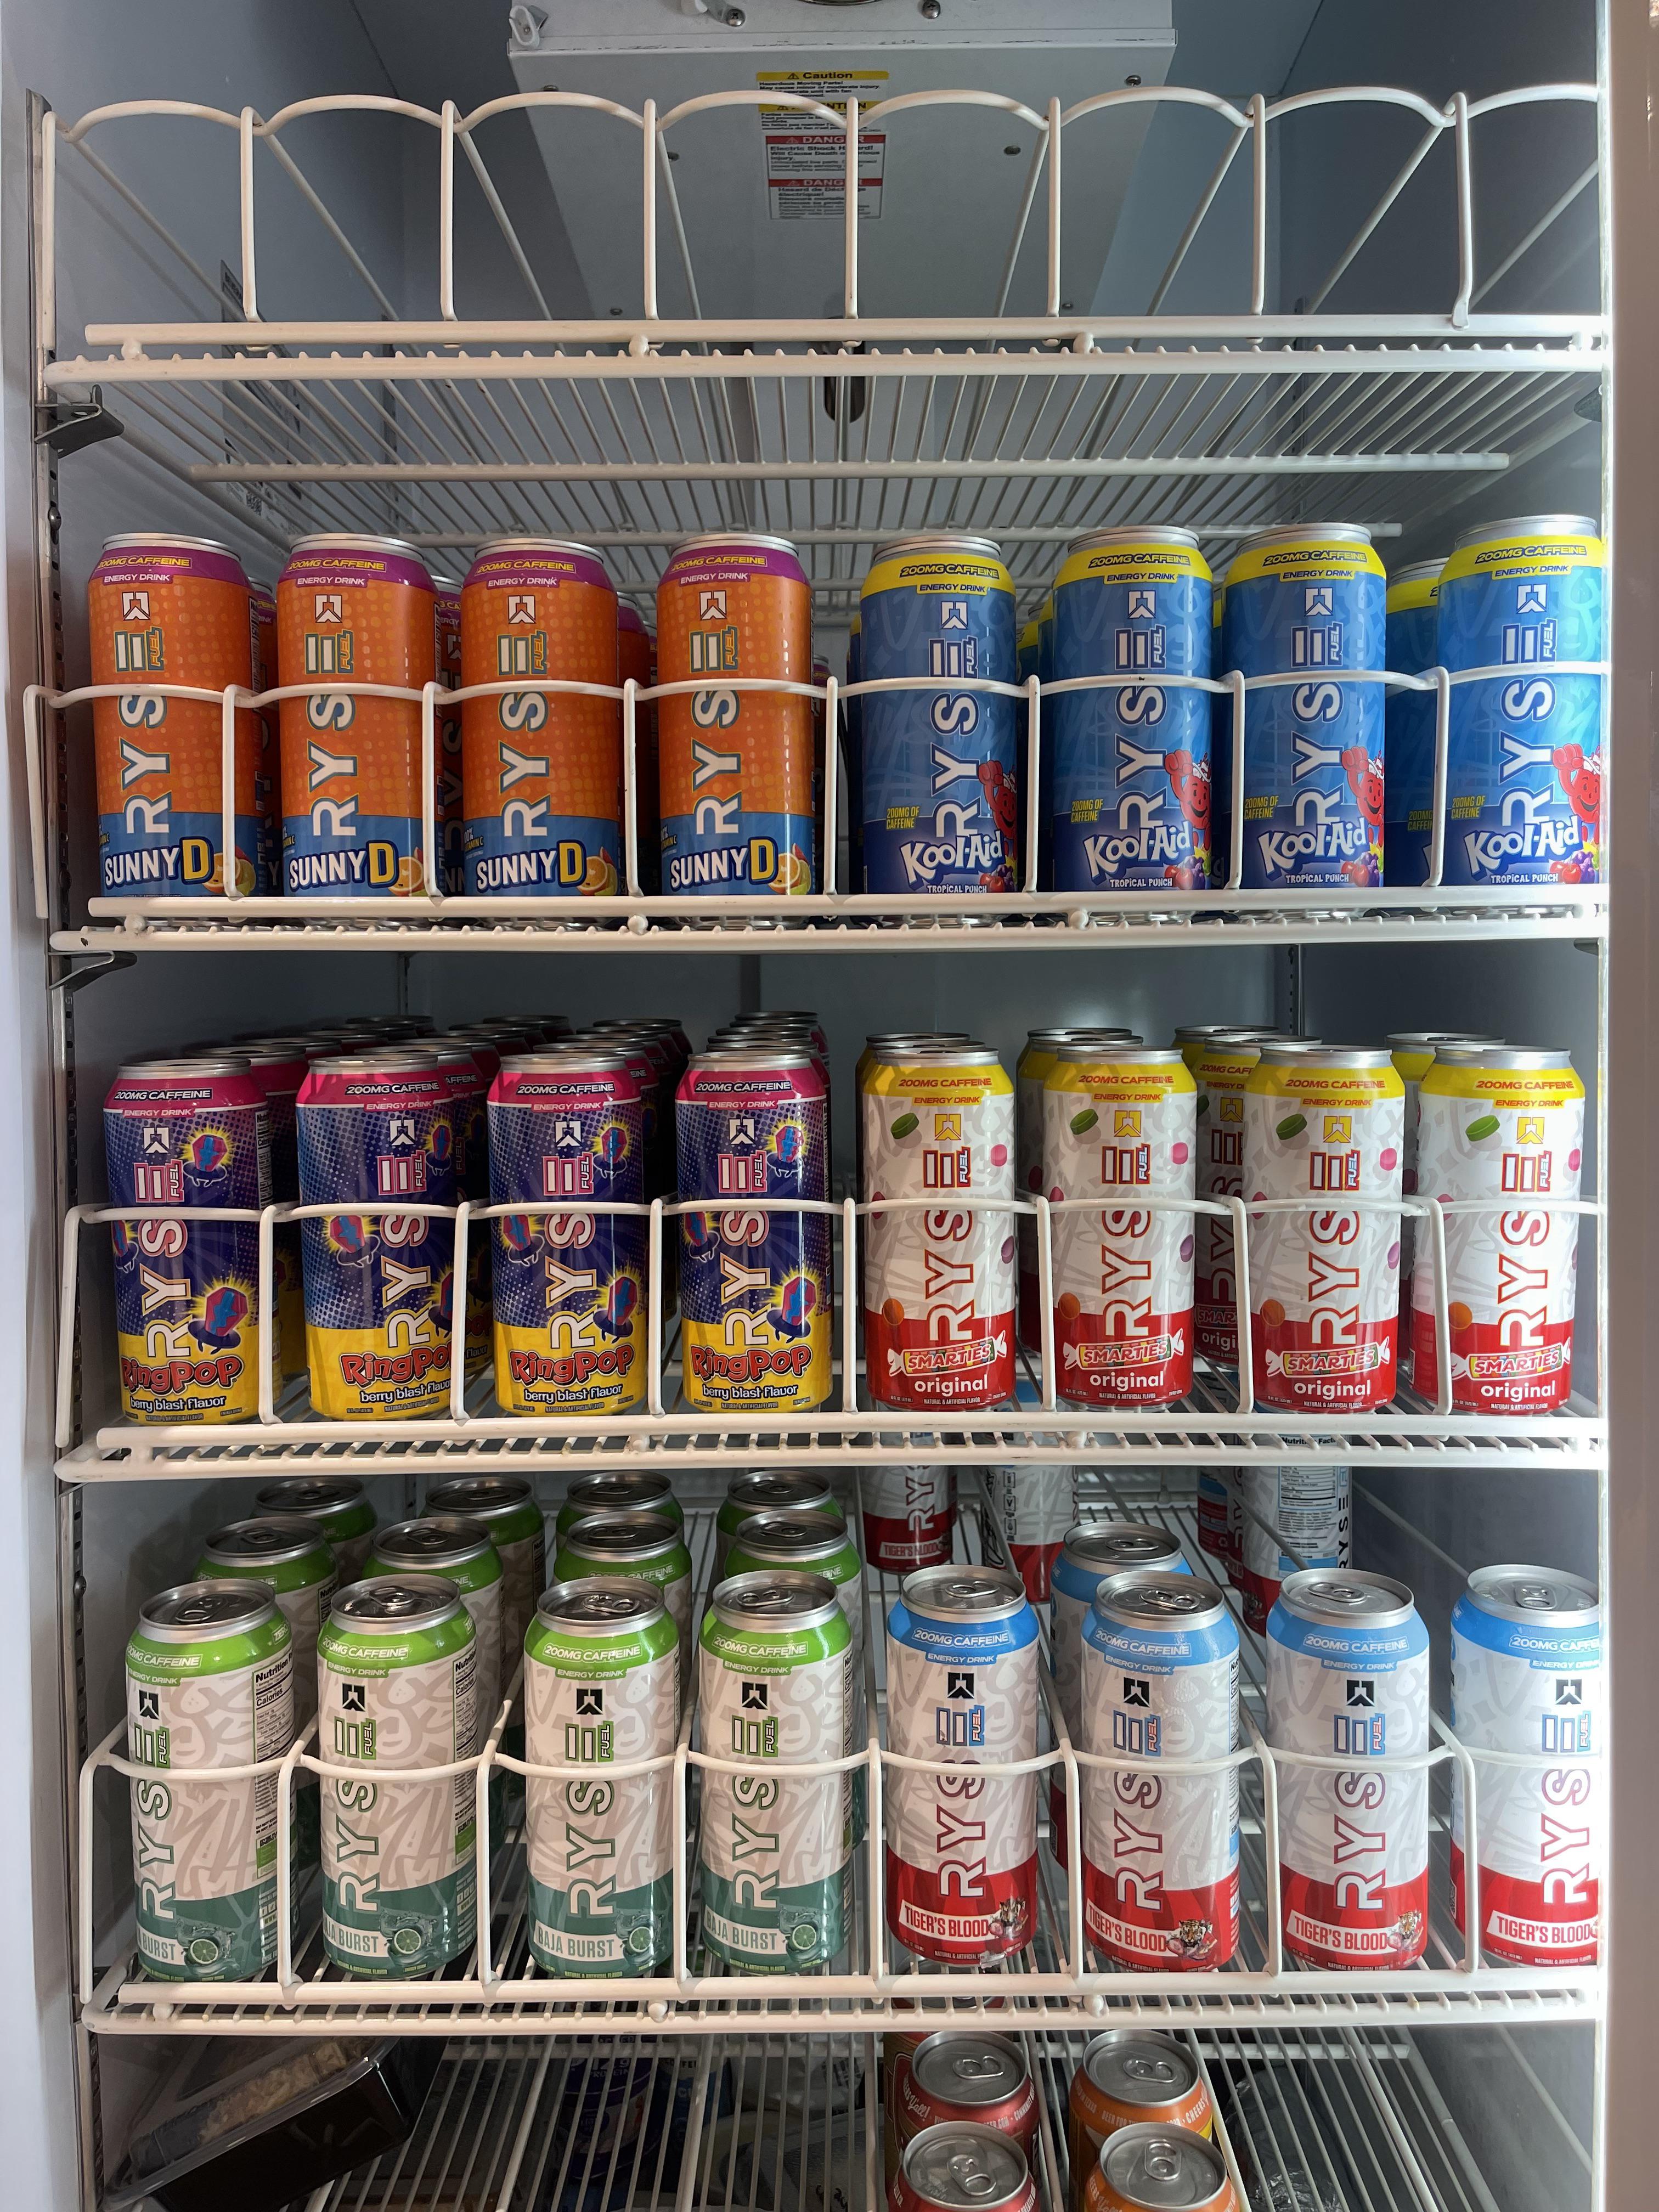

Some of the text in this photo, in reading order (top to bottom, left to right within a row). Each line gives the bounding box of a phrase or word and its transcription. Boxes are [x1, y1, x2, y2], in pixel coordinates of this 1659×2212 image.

[1089, 554, 1189, 568] 200MG CAFFEINE
[1263, 550, 1367, 566] 200MG CAFFEINE
[1475, 545, 1585, 563] 200MG CAFFEINE
[477, 560, 574, 572] 200MG CAFFEINE
[900, 565, 998, 579] 200MG CAFFEINE
[680, 574, 716, 582] ENERGY
[1107, 573, 1144, 582] ENERGY
[725, 631, 735, 667] FUEL
[1544, 623, 1553, 657] FUEL
[151, 634, 161, 667] FUEL
[966, 639, 975, 675] FUEL
[1452, 796, 1485, 808] 200MG OF
[887, 806, 919, 818] 200MG OF
[1451, 808, 1480, 819] CAFFEINE
[887, 818, 915, 829] CAFFEINE
[1085, 821, 1190, 881] Kool-Aid
[1259, 818, 1367, 873] Kool-Aid
[1466, 816, 1582, 875] Kool-Aid
[901, 831, 1004, 885] Kool-Aid
[1148, 878, 1172, 887] PUNCH
[1326, 873, 1349, 883] PUNCH
[1532, 873, 1558, 882] PUNCH
[964, 884, 986, 893] PUNCH
[517, 1082, 614, 1094] 200MG CAFFEINE
[696, 1081, 791, 1092] 200MG CAFFEINE
[899, 1077, 992, 1087] 200MG CAFFEINE
[1286, 1079, 1385, 1089] 200MG CAFFEINE
[115, 1088, 211, 1100] 200MG CAFFEINE
[756, 1153, 764, 1187] FUEL
[960, 1149, 968, 1183] FUEL
[170, 1162, 179, 1198] FUEL
[908, 1344, 991, 1369] SMARTIES
[1084, 1342, 1167, 1364] SMARTIES
[1287, 1348, 1375, 1371] SMARTIES
[1474, 1350, 1559, 1373] SMARTIES
[914, 1375, 988, 1397] original
[1090, 1372, 1164, 1391] original
[1294, 1379, 1370, 1398] original
[1481, 1381, 1555, 1398] original
[524, 1384, 622, 1403] berry blast flavor
[702, 1385, 798, 1400] berry blast flavor
[130, 1396, 225, 1412] berry blast flavor
[884, 1544, 912, 1556] TIGER'S
[714, 1638, 806, 1655] 200MG CAFFEINE
[914, 1630, 1008, 1646] 200MG CAFFEINE
[1306, 1637, 1408, 1652] 200MG CAFFEINE
[545, 1645, 641, 1661] 200MG CAFFEINE
[928, 1654, 964, 1663] ENERGY
[256, 1659, 288, 1683] Nutrition
[557, 1669, 623, 1678] ENERGY DRINK
[1324, 1660, 1395, 1670] ENERGY DRINK
[257, 1688, 283, 1707] Calories
[973, 1709, 981, 1741] FUEL
[364, 1722, 373, 1756] FUEL
[601, 1725, 610, 1757] FUEL
[906, 1905, 989, 1936] TIGER'S BLOOD
[1088, 1904, 1167, 1952] TIGER'S BLOOD
[1497, 1916, 1592, 1943] TIGER'S BLOOD
[338, 1930, 379, 1953] BURST
[706, 1914, 776, 1950] BAJA BURST
[1295, 1915, 1387, 1950] TIGER'S BLOOD
[143, 1940, 176, 1960] BURST
[538, 1931, 614, 1957] BAJA BURST
[1186, 2097, 1205, 2124] CHEERS
